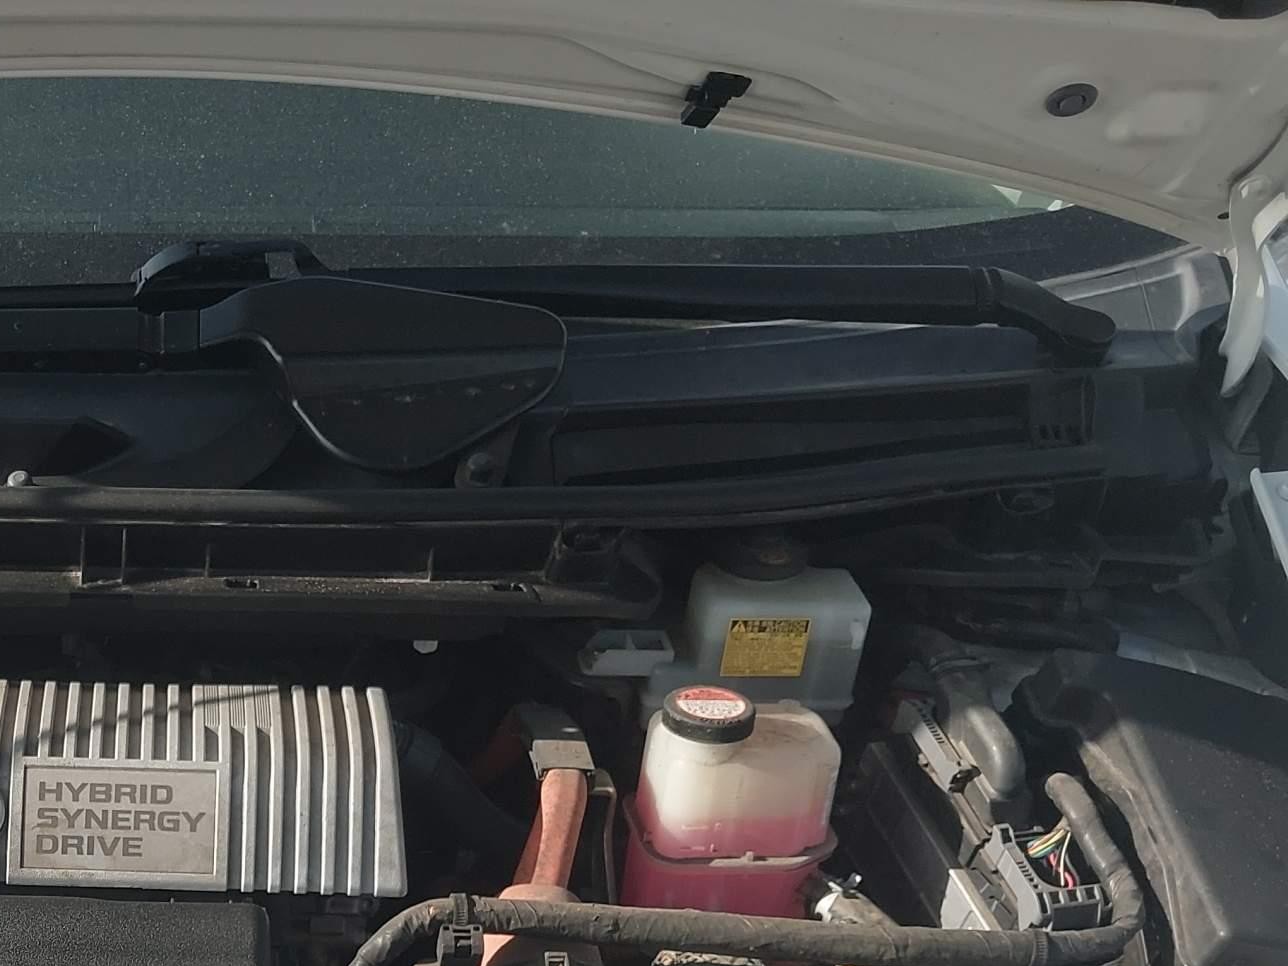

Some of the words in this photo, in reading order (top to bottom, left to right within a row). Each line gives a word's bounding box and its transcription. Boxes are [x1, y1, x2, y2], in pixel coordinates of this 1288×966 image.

[38, 781, 174, 805] HYBRID
[32, 807, 206, 833] SYNERGY
[35, 834, 144, 857] DRIVE
